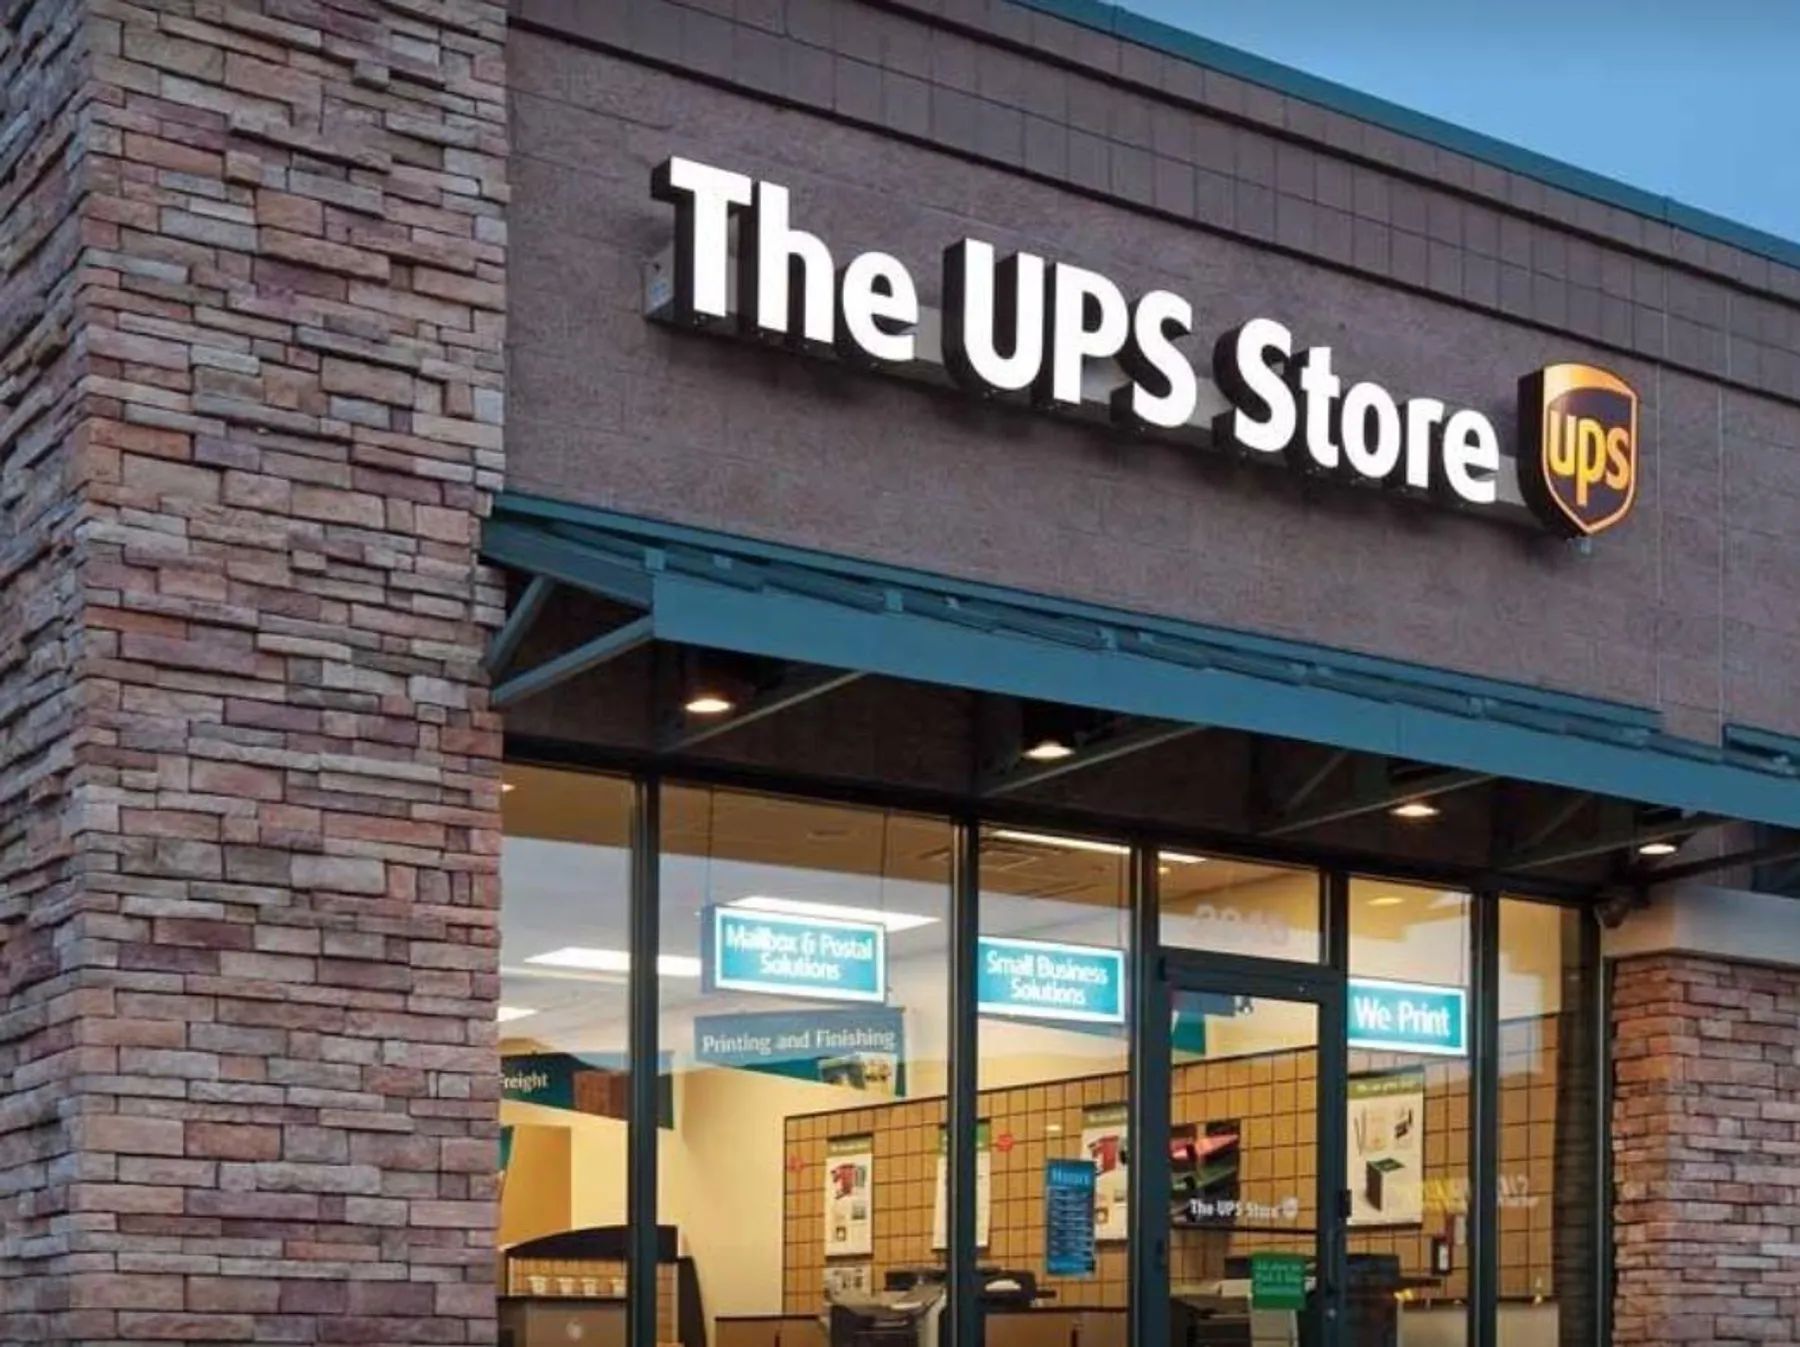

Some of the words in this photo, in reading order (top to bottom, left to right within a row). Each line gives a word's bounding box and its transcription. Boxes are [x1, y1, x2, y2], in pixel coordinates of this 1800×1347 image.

[670, 156, 918, 361] The
[963, 237, 1197, 429] UPS
[1235, 317, 1499, 504] Store
[1548, 410, 1632, 507] ups
[725, 924, 798, 953] Mailbox
[819, 933, 873, 960] Postal
[760, 952, 841, 980] Solutions
[986, 950, 1034, 977] Small
[1037, 955, 1108, 985] Business
[1010, 977, 1085, 1005] Solutions
[1354, 995, 1391, 1031] We
[1398, 1001, 1450, 1037] Print
[702, 1034, 772, 1056] Printing
[778, 1032, 809, 1050] and
[816, 1027, 896, 1051] Finishing
[1189, 1198, 1214, 1216] The
